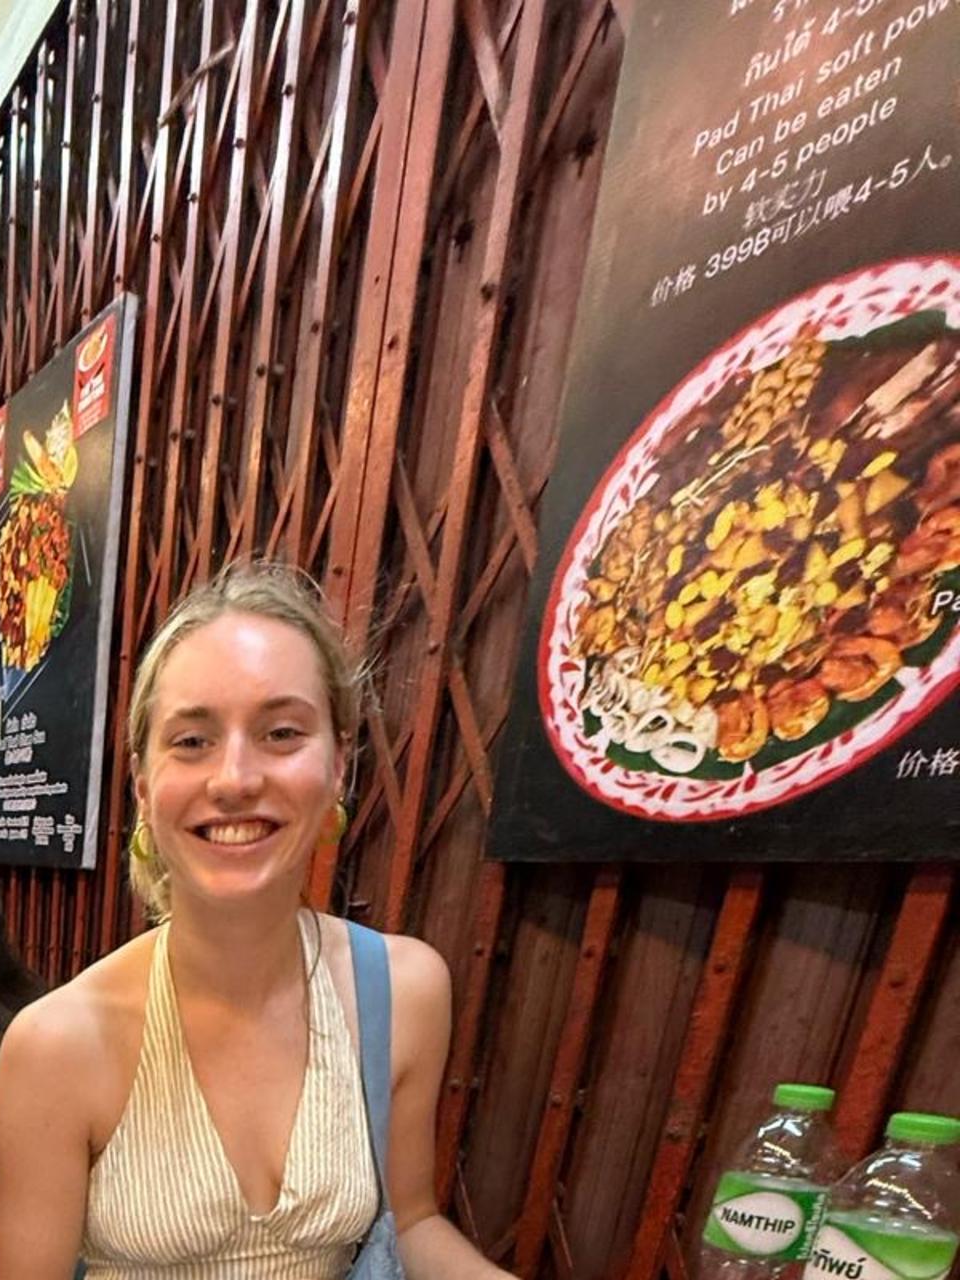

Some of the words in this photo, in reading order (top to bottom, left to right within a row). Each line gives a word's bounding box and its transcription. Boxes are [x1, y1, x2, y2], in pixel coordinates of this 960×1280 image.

[692, 106, 740, 158] Pad
[749, 69, 806, 123] Thai
[816, 31, 876, 84] soft
[882, 0, 950, 50] pow
[716, 135, 764, 175] Can
[773, 111, 807, 144] be
[817, 56, 902, 119] eaten
[702, 186, 734, 216] by
[740, 150, 789, 193] 4-5
[795, 97, 897, 171] people
[651, 262, 696, 307] 价格
[931, 591, 960, 616] Pa
[896, 747, 959, 779] 价格
[720, 1207, 796, 1235] NAMTHIP
